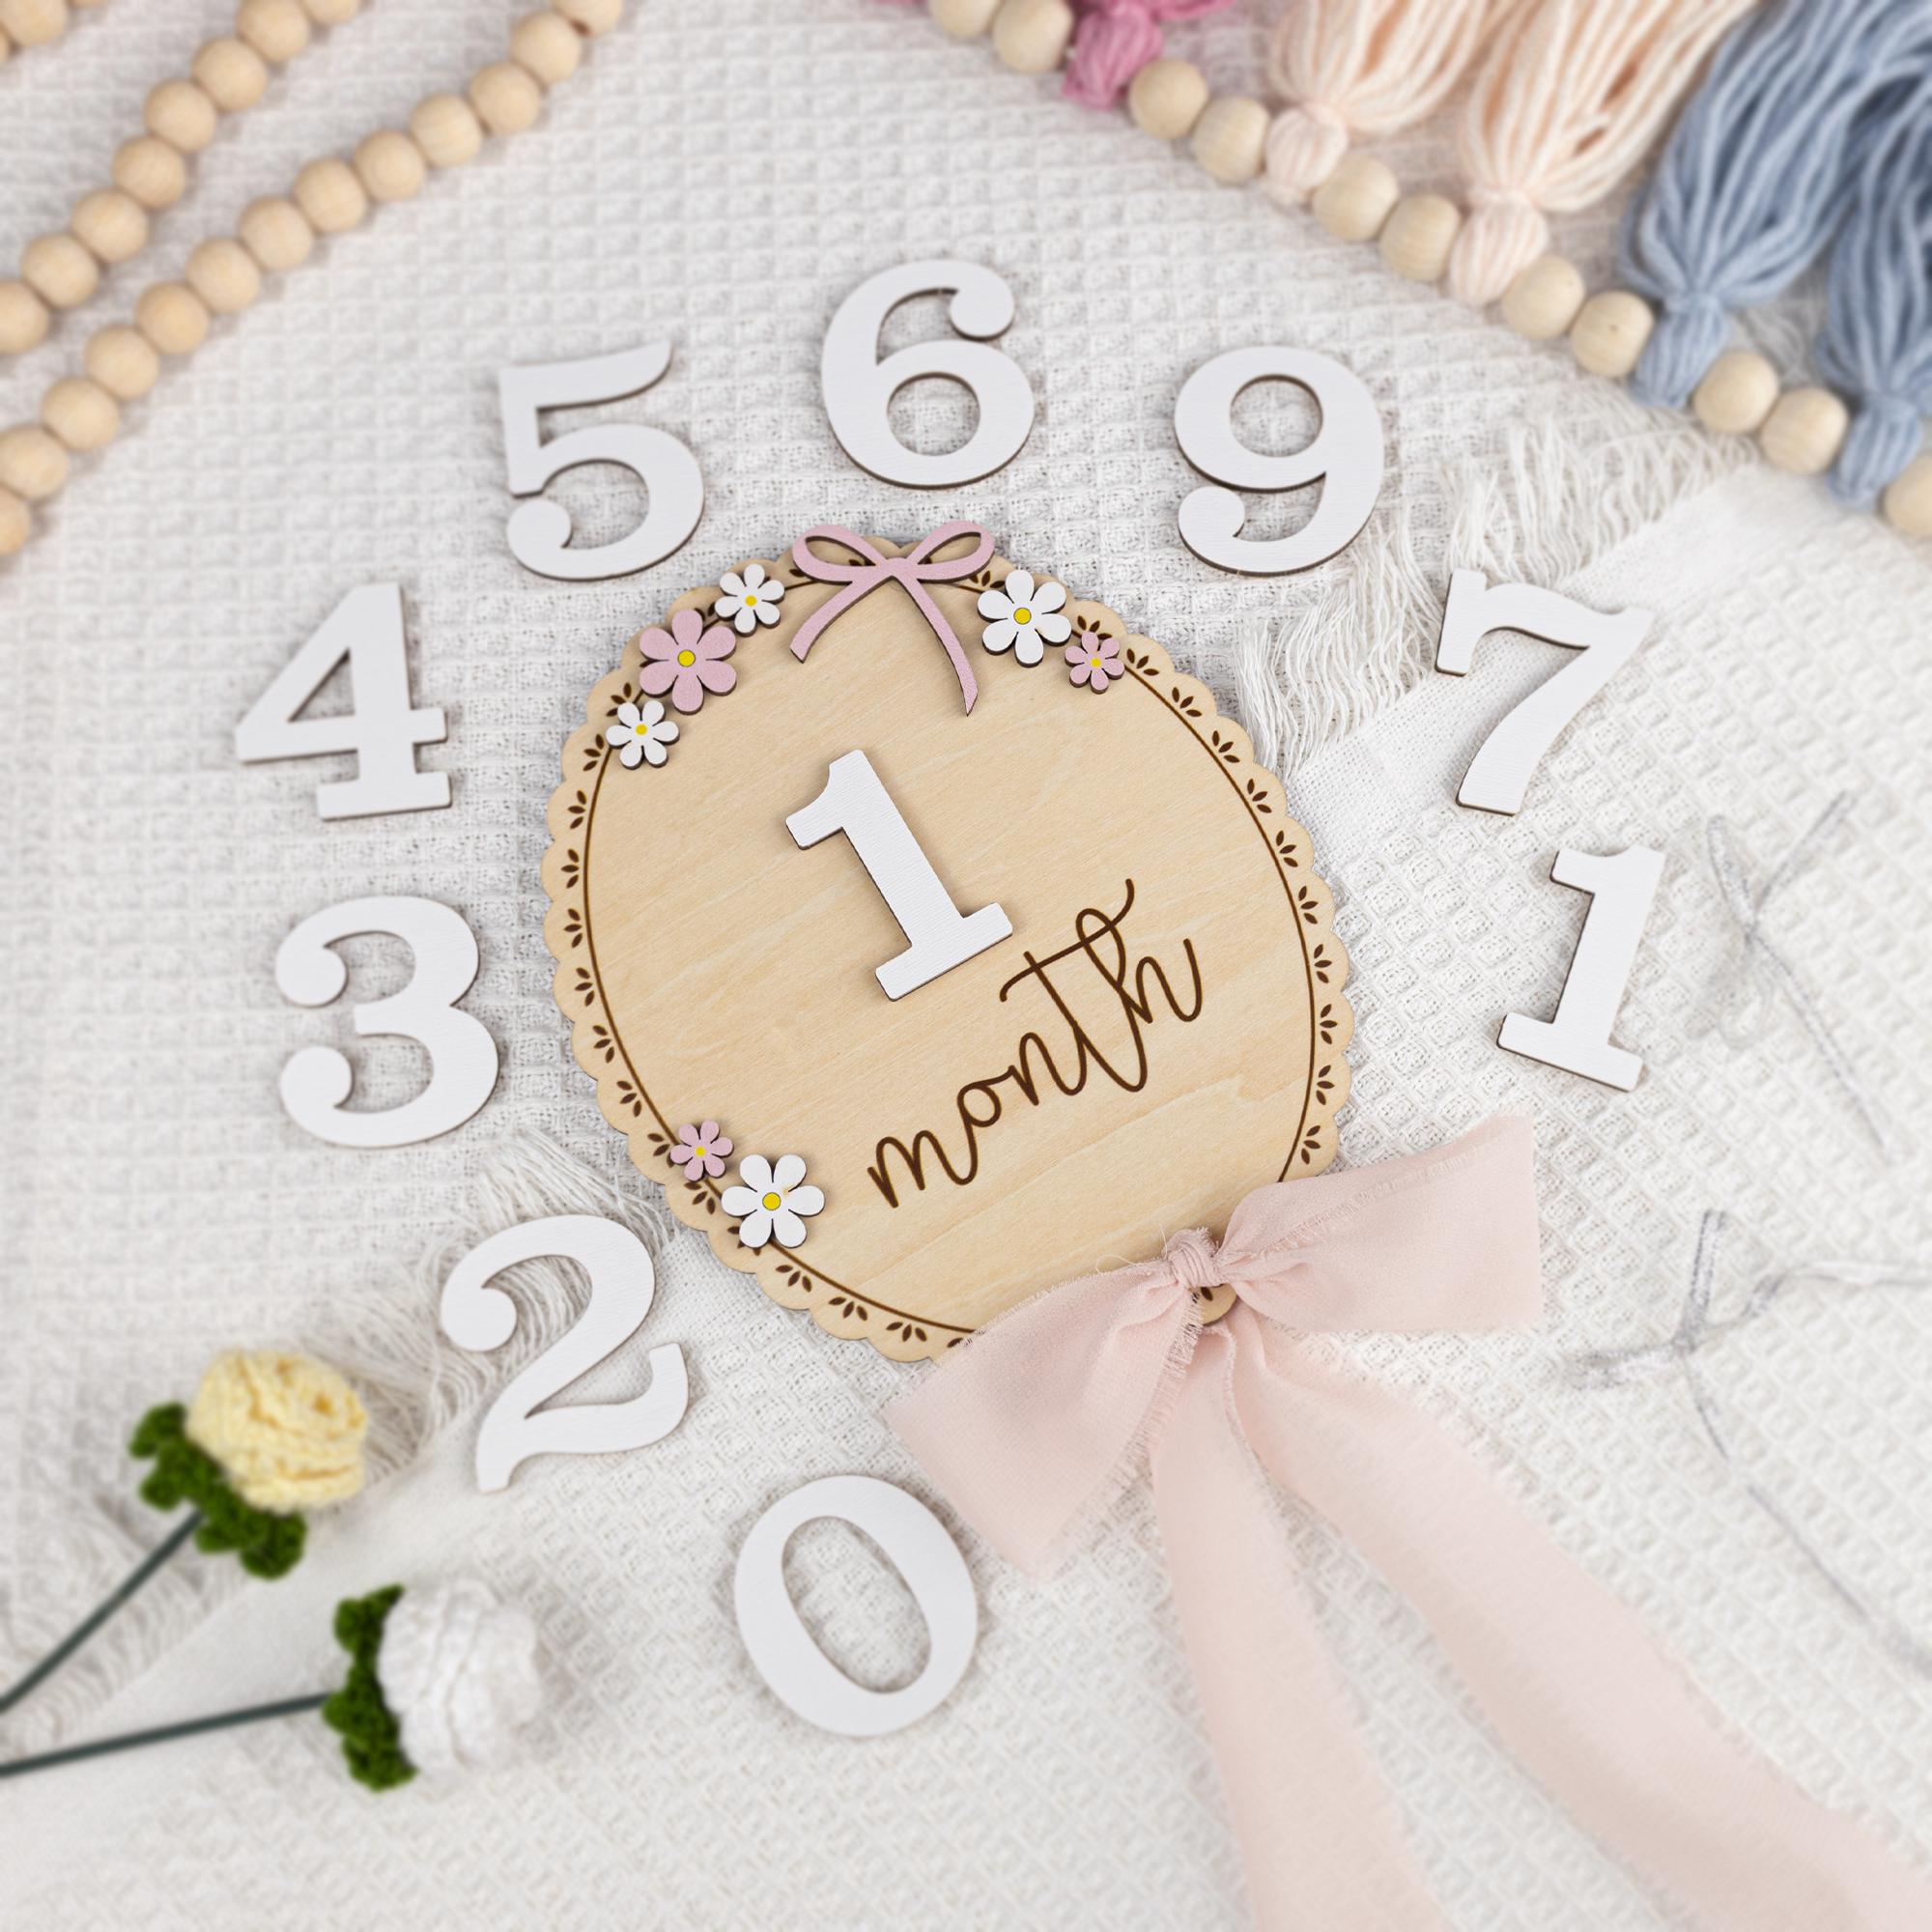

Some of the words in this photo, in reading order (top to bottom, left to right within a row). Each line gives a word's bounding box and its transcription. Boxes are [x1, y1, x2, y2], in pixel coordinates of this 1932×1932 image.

[498, 341, 704, 580] 5
[822, 261, 1034, 488] 6
[1174, 346, 1385, 576] 9
[236, 583, 453, 820] 4
[1436, 572, 1653, 815] 7
[786, 750, 1012, 1000] 1
[1497, 846, 1665, 1092] 1
[275, 897, 499, 1147] 3
[867, 878, 1202, 1208] month
[440, 1215, 690, 1492] 2
[734, 1476, 978, 1738] 0
